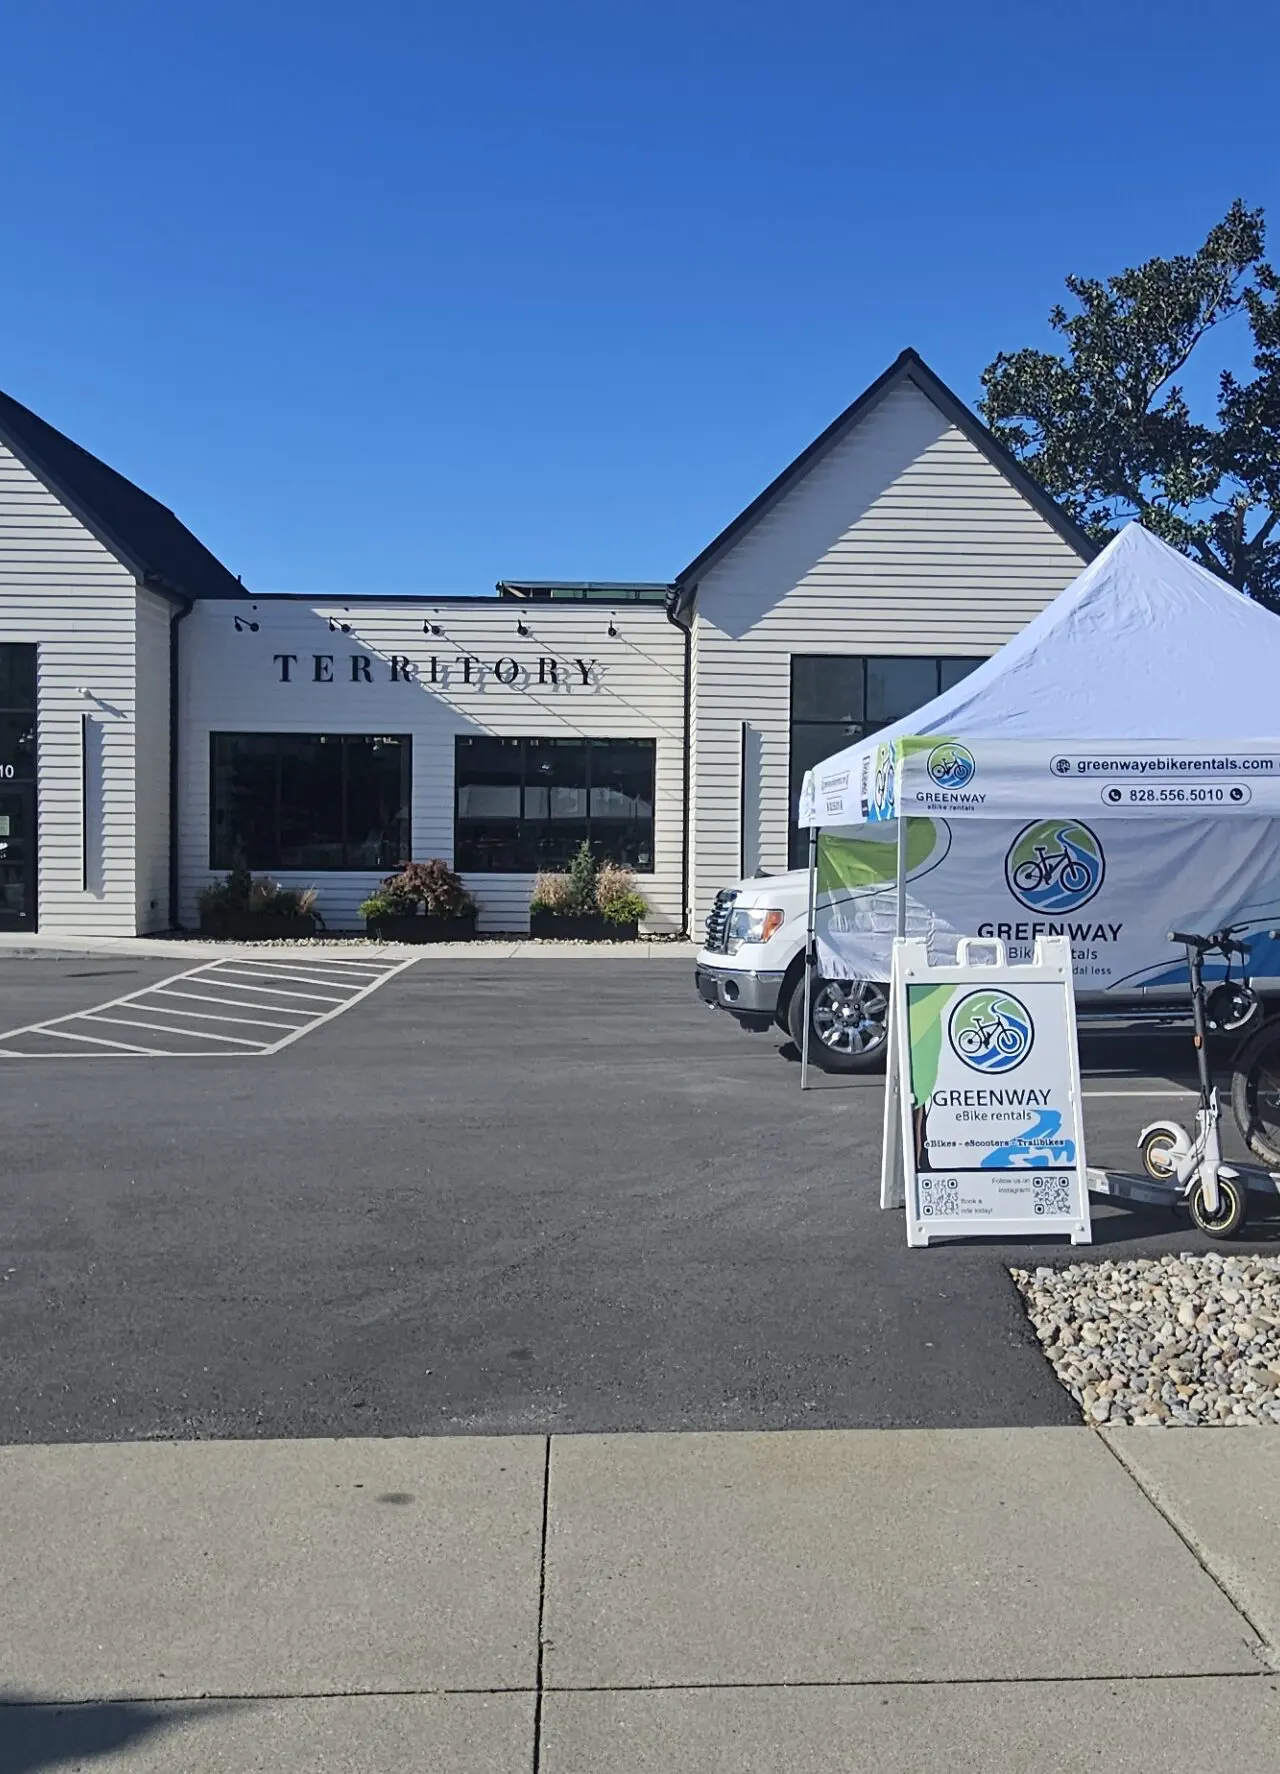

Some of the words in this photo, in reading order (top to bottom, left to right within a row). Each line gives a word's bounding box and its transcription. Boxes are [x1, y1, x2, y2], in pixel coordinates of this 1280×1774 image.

[273, 654, 600, 686] TERRITORY
[1077, 757, 1274, 774] greenwayebikerentals.com
[916, 791, 987, 804] GREENWAY
[1129, 788, 1224, 802] 828.556.5010
[949, 803, 975, 812] rentals
[977, 922, 1124, 942] GREENWAY
[1091, 966, 1112, 975] less
[933, 1089, 1052, 1107] GREENWAY
[955, 1110, 988, 1121] eBike
[991, 1109, 1032, 1121] rentals
[925, 1139, 957, 1148] eBikes
[964, 1139, 1010, 1147] eScooters
[1017, 1138, 1064, 1147] Trailbikes
